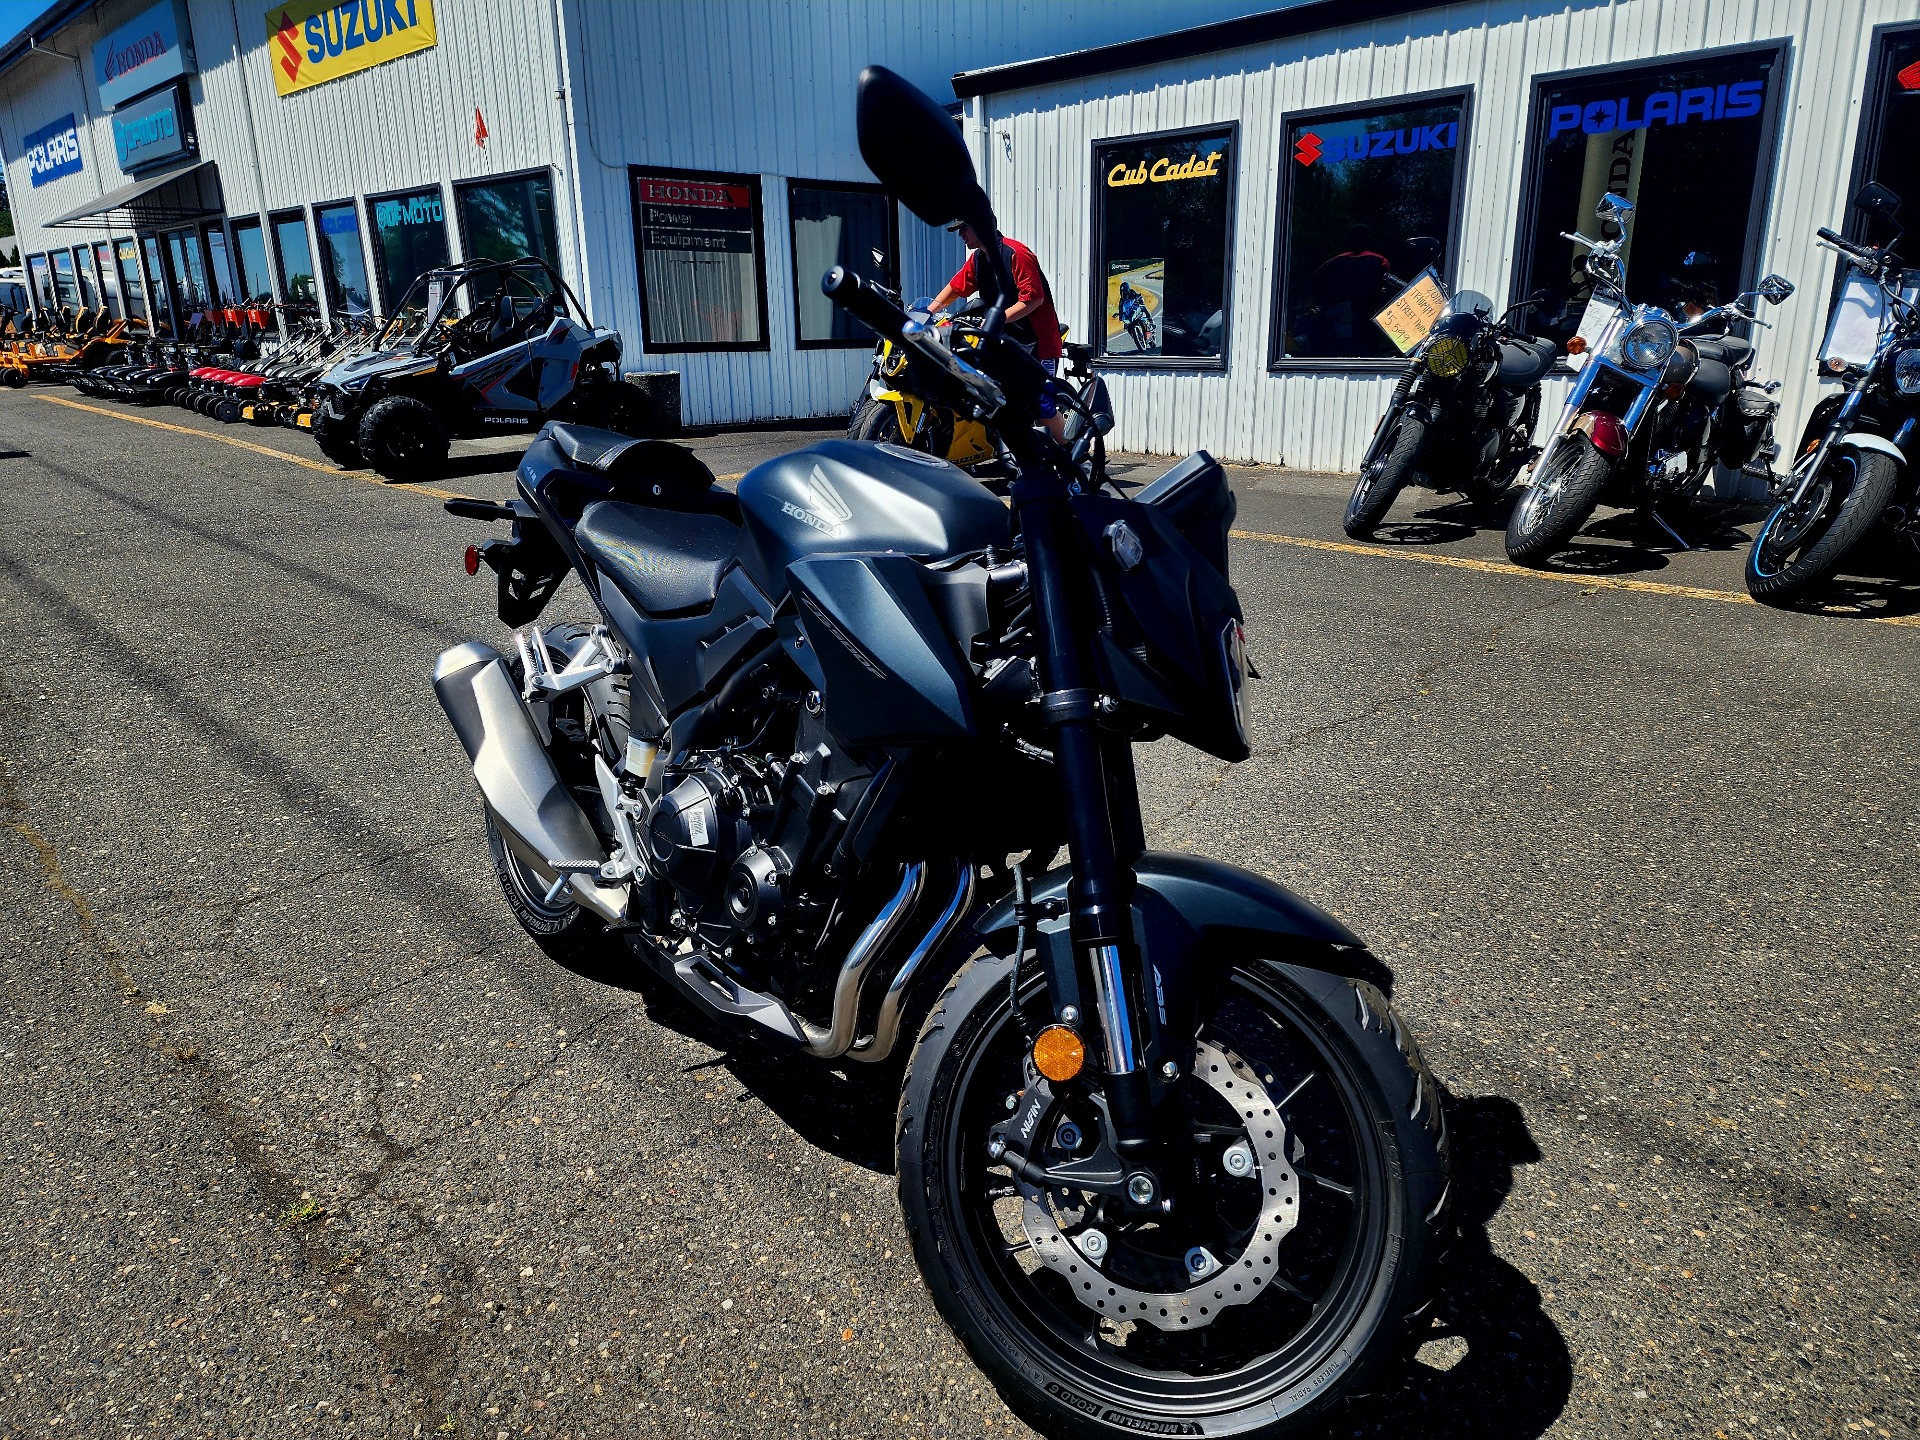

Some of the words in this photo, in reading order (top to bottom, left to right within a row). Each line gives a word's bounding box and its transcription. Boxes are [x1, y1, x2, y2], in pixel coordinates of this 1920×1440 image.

[305, 0, 417, 64] SUZUKI
[116, 30, 167, 77] HONDA
[1549, 80, 1763, 139] POLARIS
[27, 128, 79, 176] POLARIS
[1323, 122, 1457, 163] SUZUKI
[1108, 162, 1147, 187] Cub
[1150, 151, 1222, 183] Cadet
[648, 184, 735, 203] HONDA
[649, 208, 692, 224] Power
[650, 230, 726, 249] Equipment
[1396, 297, 1416, 320] STREET
[1413, 318, 1428, 336] TWIN
[1410, 288, 1436, 317] TRIUMPH
[781, 501, 841, 539] HONDA
[504, 883, 521, 909] ROAD
[1152, 963, 1167, 1025] ABS
[1048, 1383, 1059, 1394] 6
[1313, 1361, 1340, 1387] TUBELESS
[1060, 1391, 1096, 1413] ROAD
[1289, 1385, 1312, 1402] RADIAL
[1108, 1412, 1180, 1434] MICHELIN
